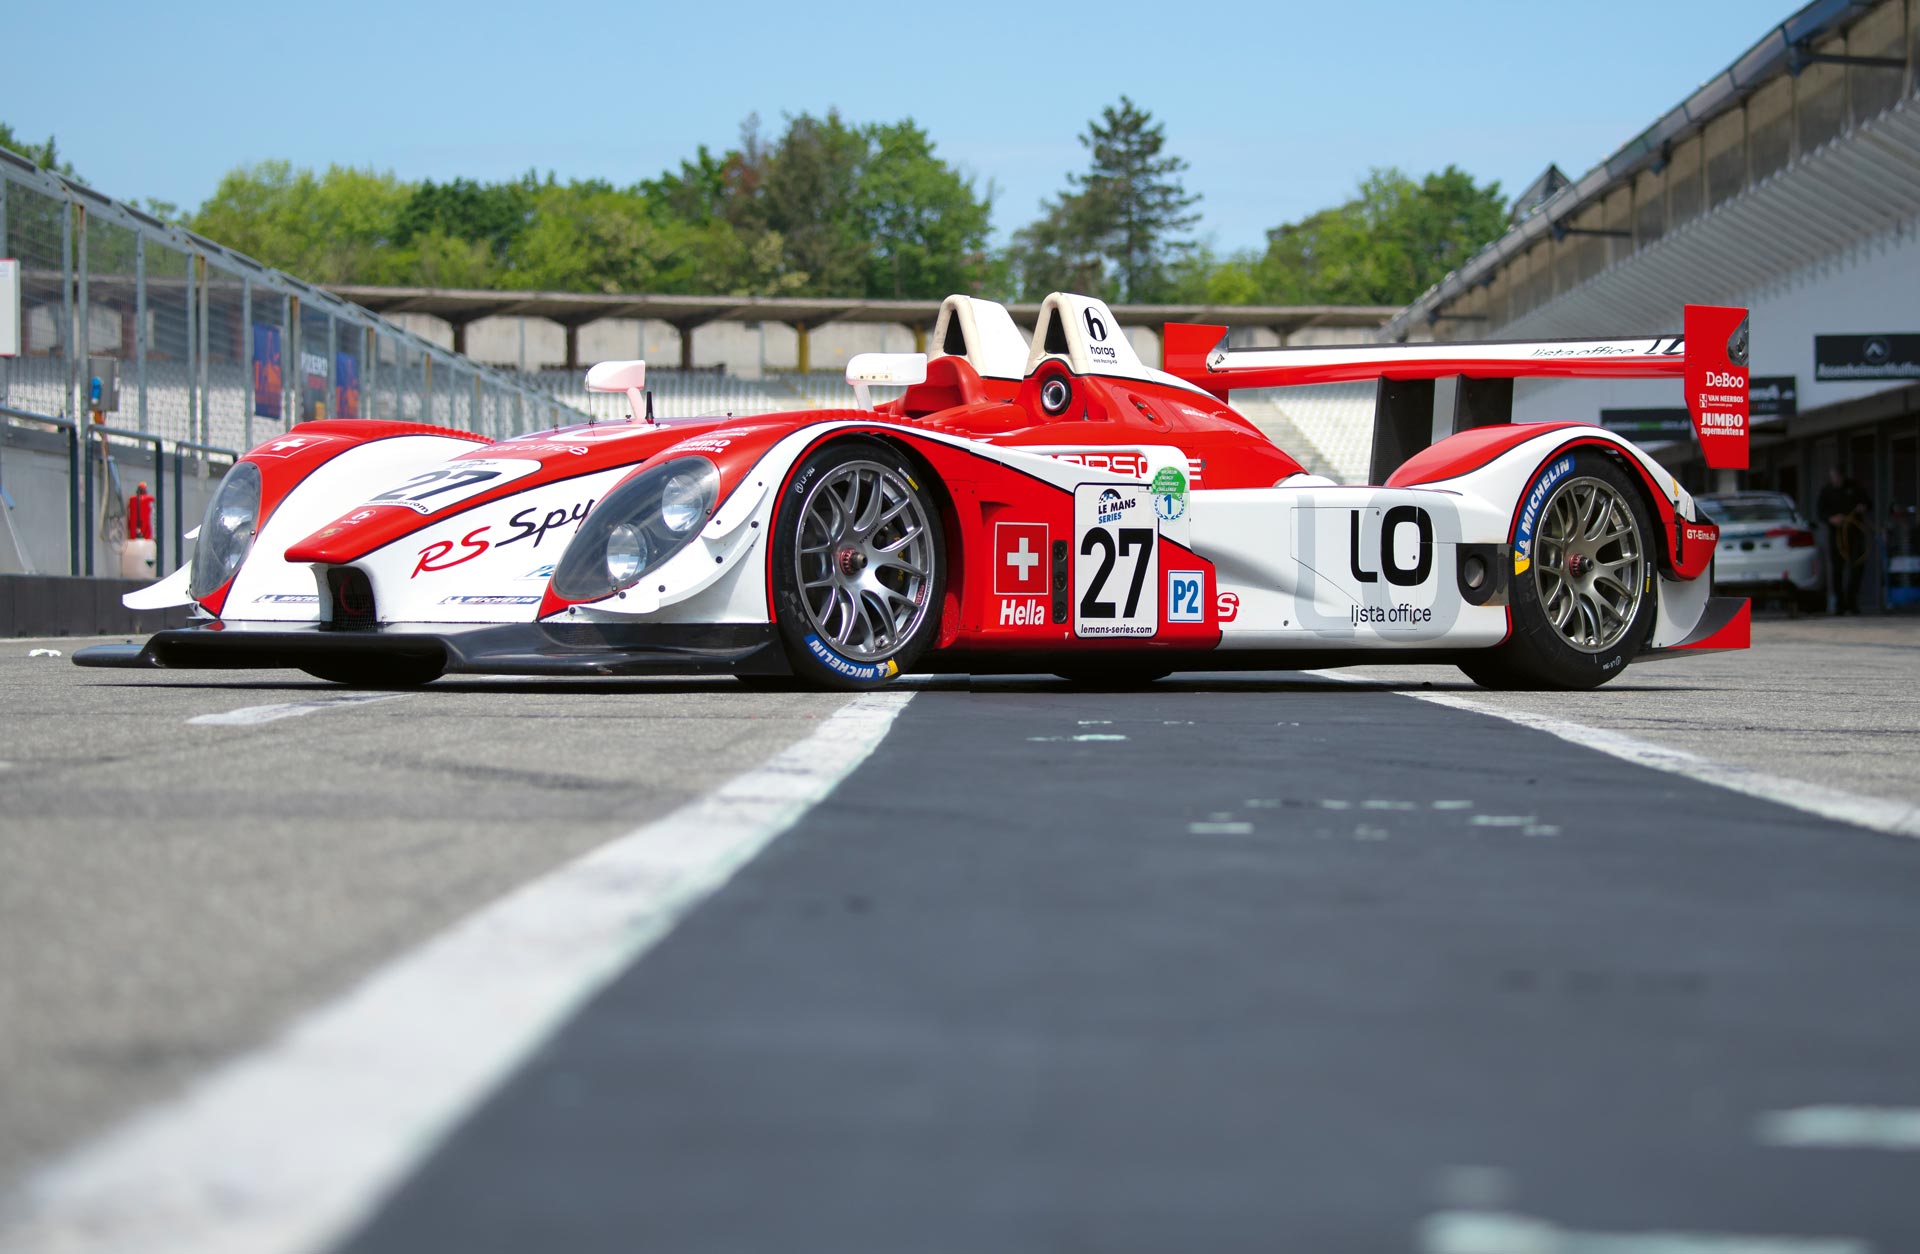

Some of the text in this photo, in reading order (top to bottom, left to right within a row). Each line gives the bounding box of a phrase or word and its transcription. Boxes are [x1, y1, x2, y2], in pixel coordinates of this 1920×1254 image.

[1090, 344, 1116, 358] horag
[1705, 371, 1745, 388] DeBoo
[1708, 394, 1720, 402] VAN
[1701, 412, 1744, 427] JUMBO
[1701, 427, 1739, 437] supermarkten
[369, 470, 502, 501] 27
[1098, 498, 1136, 515] LE MANS
[1164, 494, 1171, 515] 1
[1521, 459, 1570, 535] MICHELIN
[1098, 512, 1122, 524] SERIES
[1686, 528, 1716, 541] GT-Eins.de
[410, 526, 492, 579] RS
[1351, 505, 1433, 586] LO
[1080, 527, 1154, 618] 27
[1173, 580, 1199, 613] P2
[1000, 599, 1045, 626] Hella
[1351, 603, 1432, 623] lista office
[1080, 623, 1153, 634] lemans-series.com
[809, 639, 875, 678] MICHELIN
